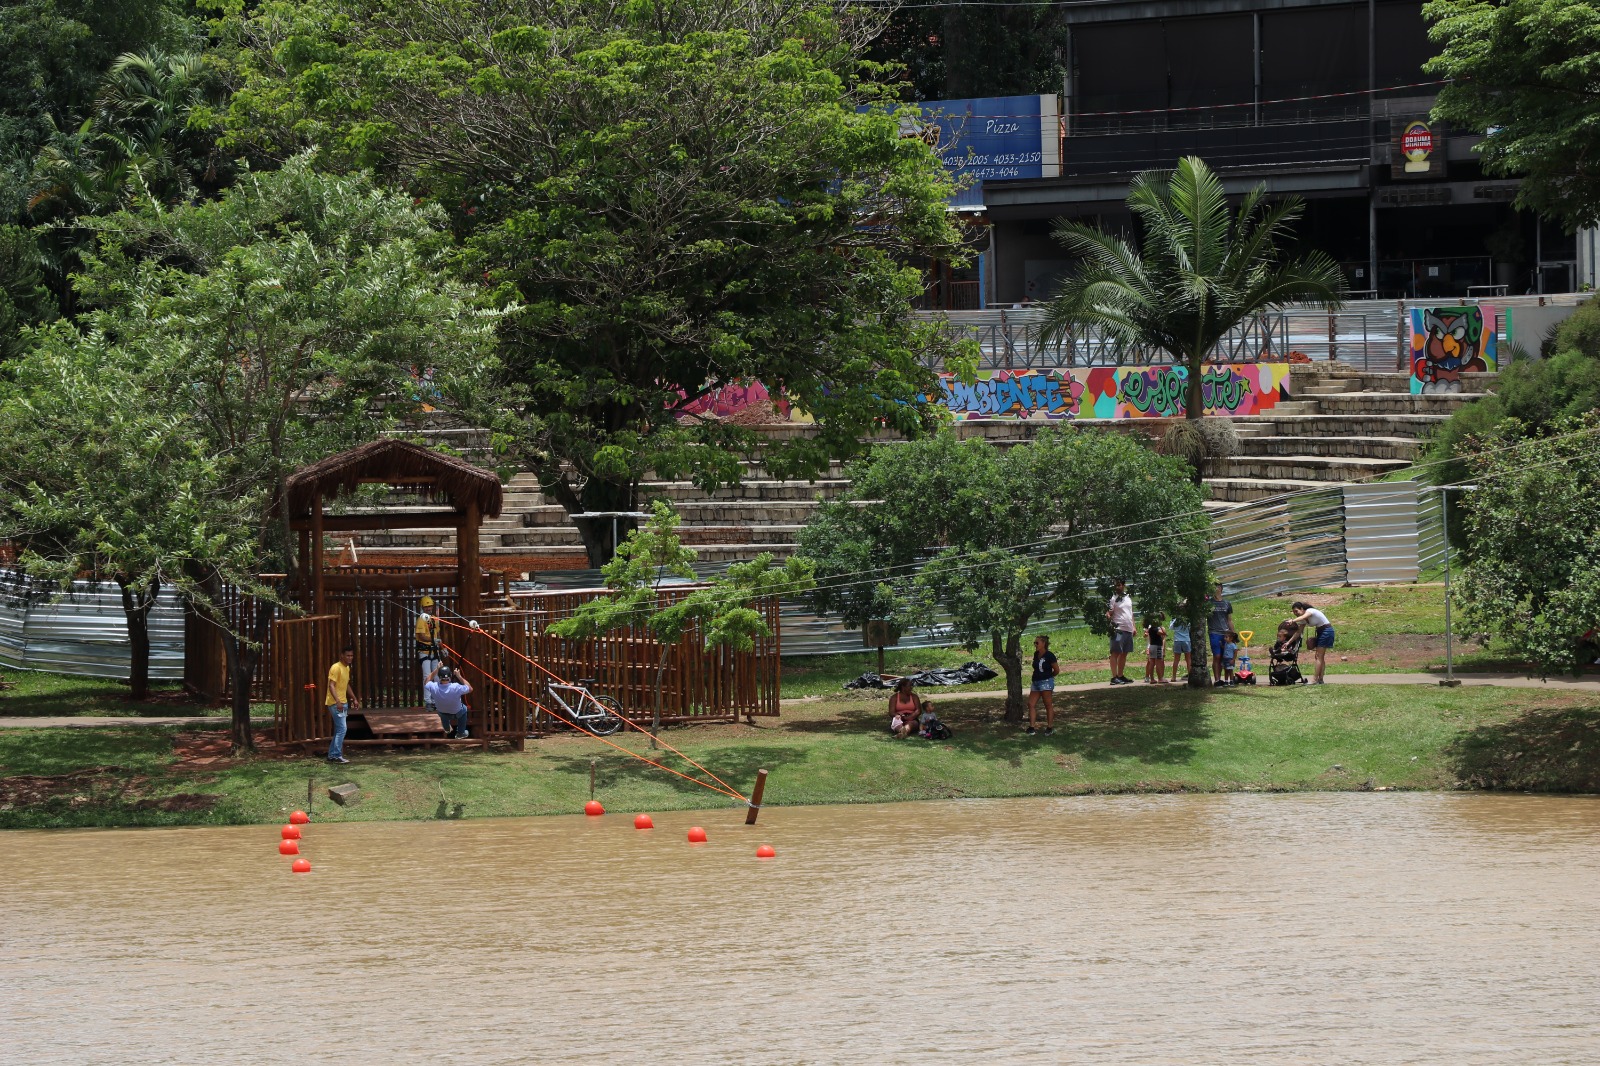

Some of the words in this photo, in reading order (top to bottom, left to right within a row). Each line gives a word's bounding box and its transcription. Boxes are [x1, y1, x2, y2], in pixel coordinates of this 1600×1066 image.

[986, 118, 1020, 134] Pizza
[1405, 136, 1431, 147] BRAHMA
[994, 152, 1041, 165] 4033-2150
